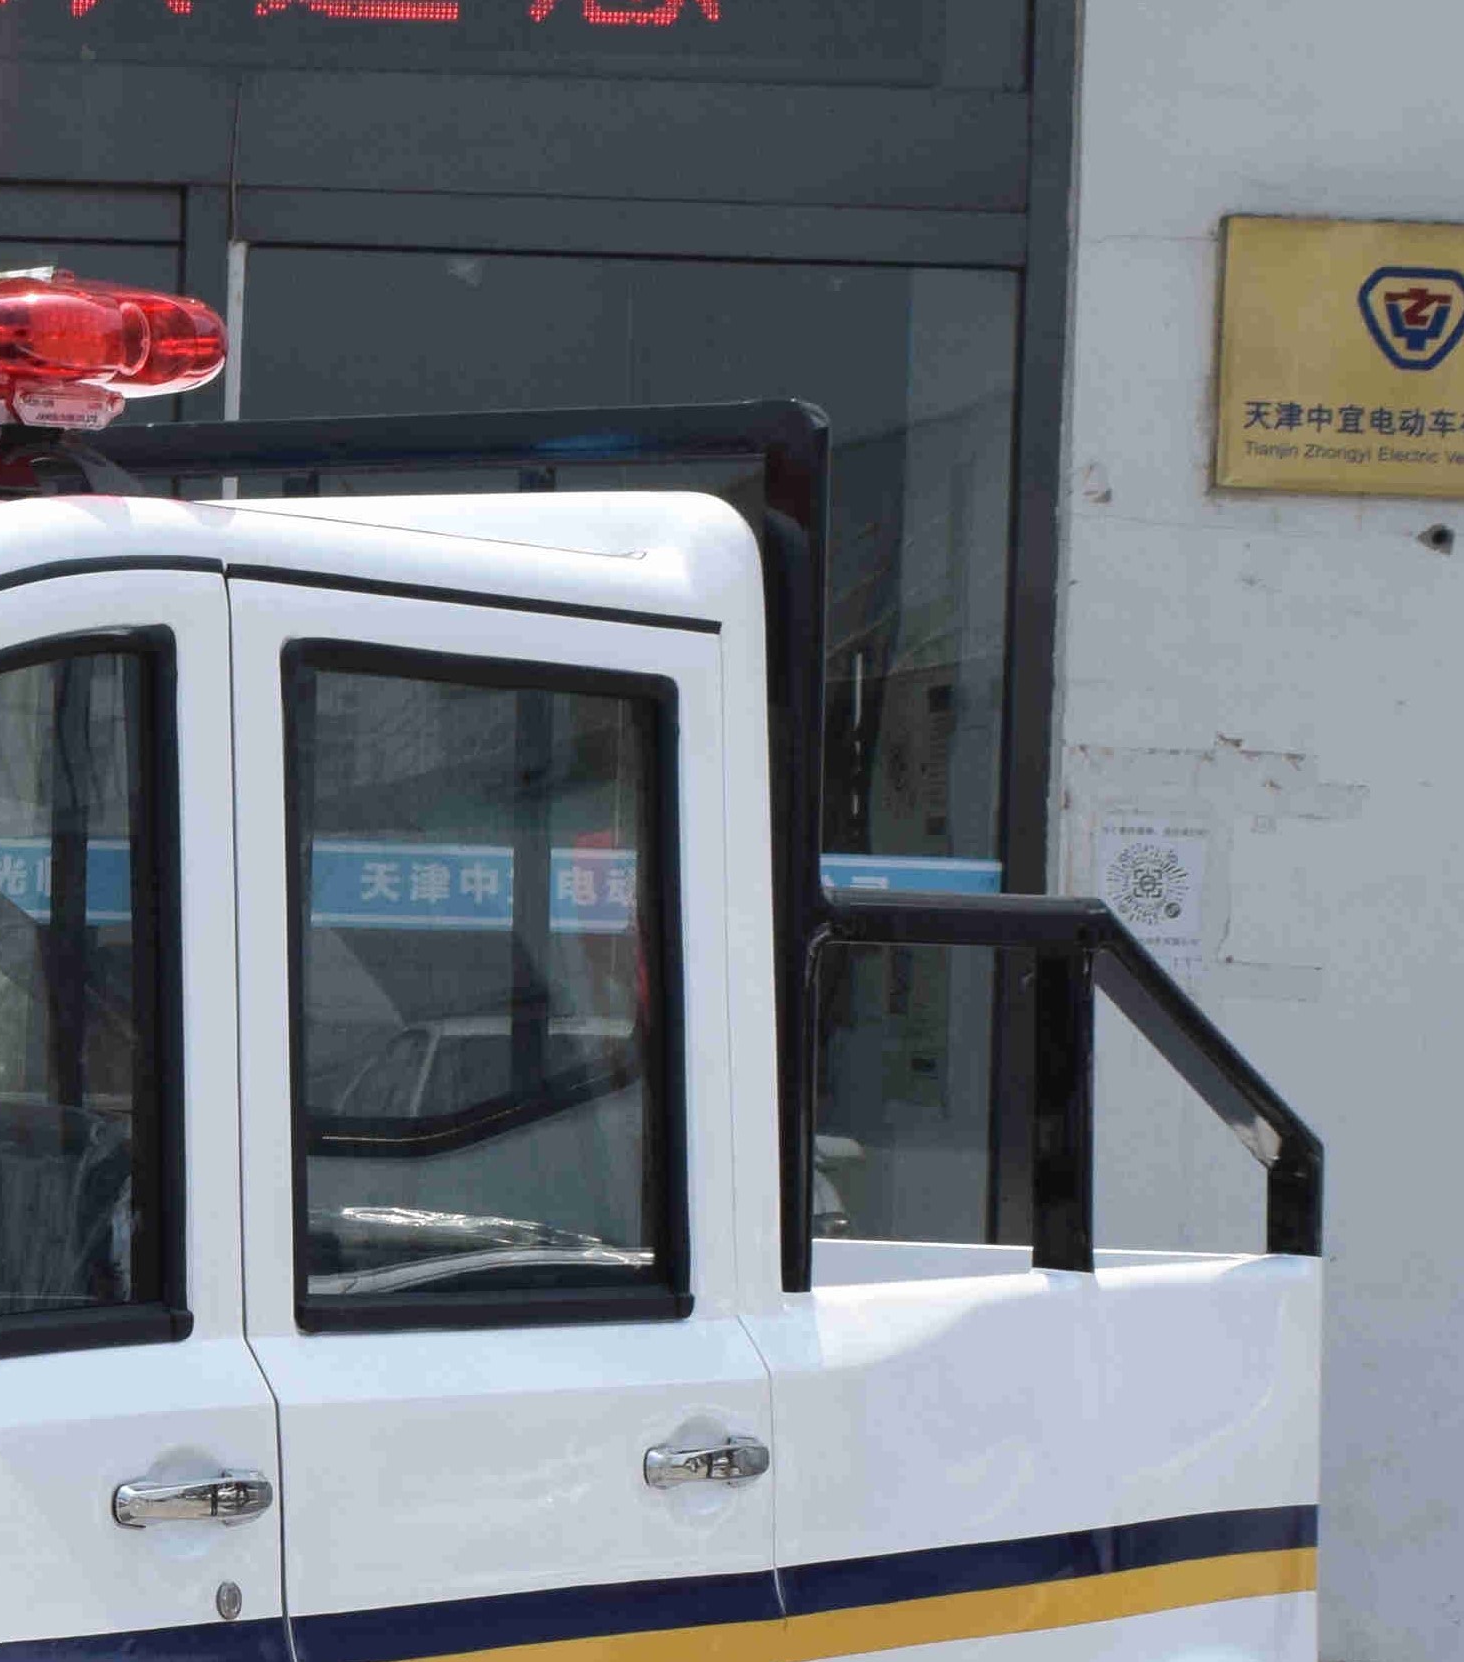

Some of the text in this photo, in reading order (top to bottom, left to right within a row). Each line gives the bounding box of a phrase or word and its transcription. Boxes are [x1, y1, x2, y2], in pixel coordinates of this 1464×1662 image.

[1243, 401, 1464, 439] 天津中宜电动车
